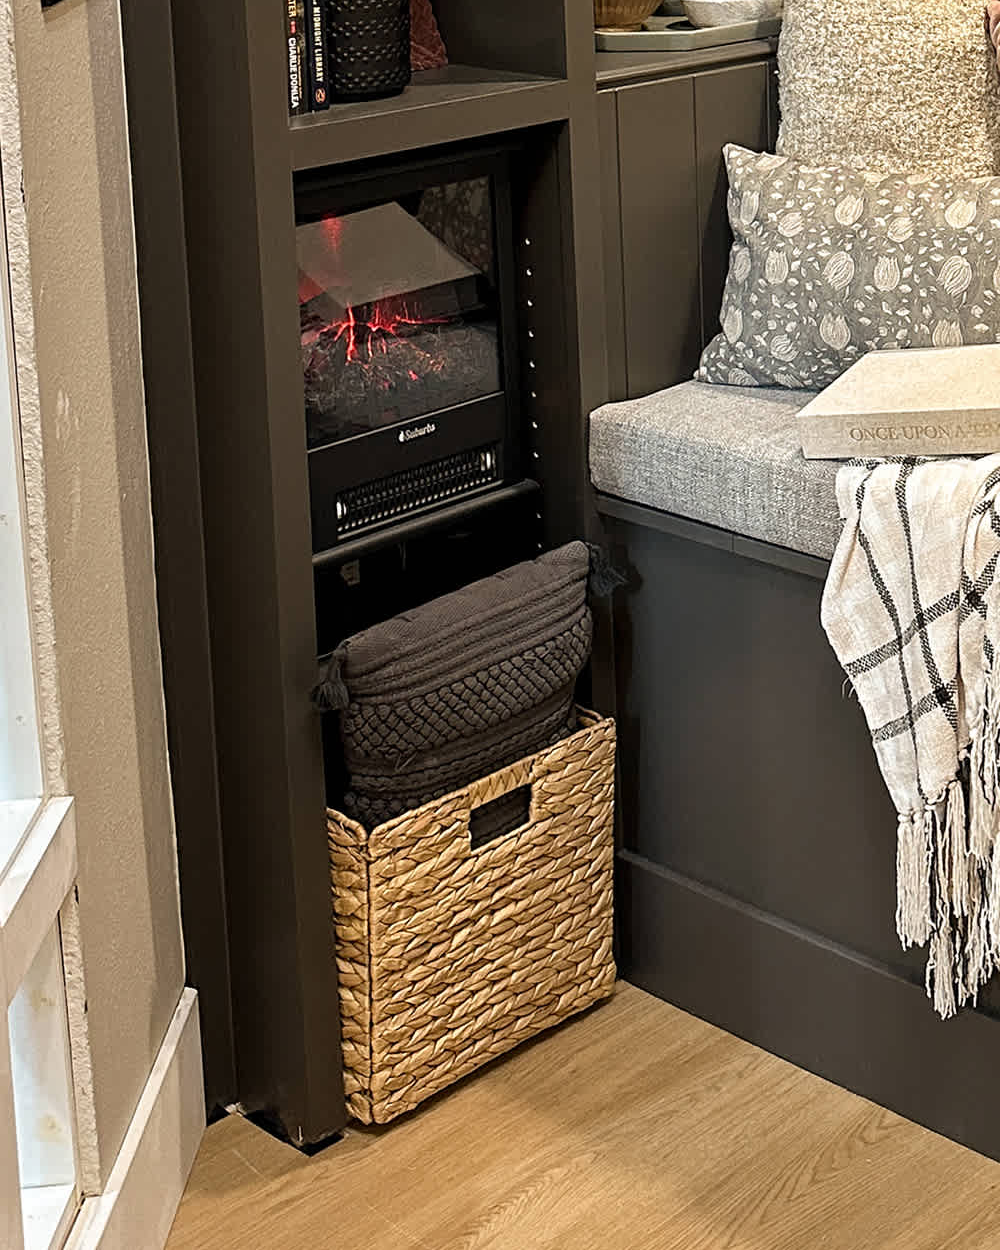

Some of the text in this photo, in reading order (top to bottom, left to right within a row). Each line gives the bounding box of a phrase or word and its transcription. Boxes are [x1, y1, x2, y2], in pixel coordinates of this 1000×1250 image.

[313, 7, 322, 46] MIDNIGHT
[288, 37, 299, 72] CHARLIE
[315, 49, 323, 82] LIBRARY
[290, 73, 299, 108] DONLEA
[849, 426, 899, 442] ONCE
[901, 424, 951, 440] UPON
[953, 424, 967, 439] A
